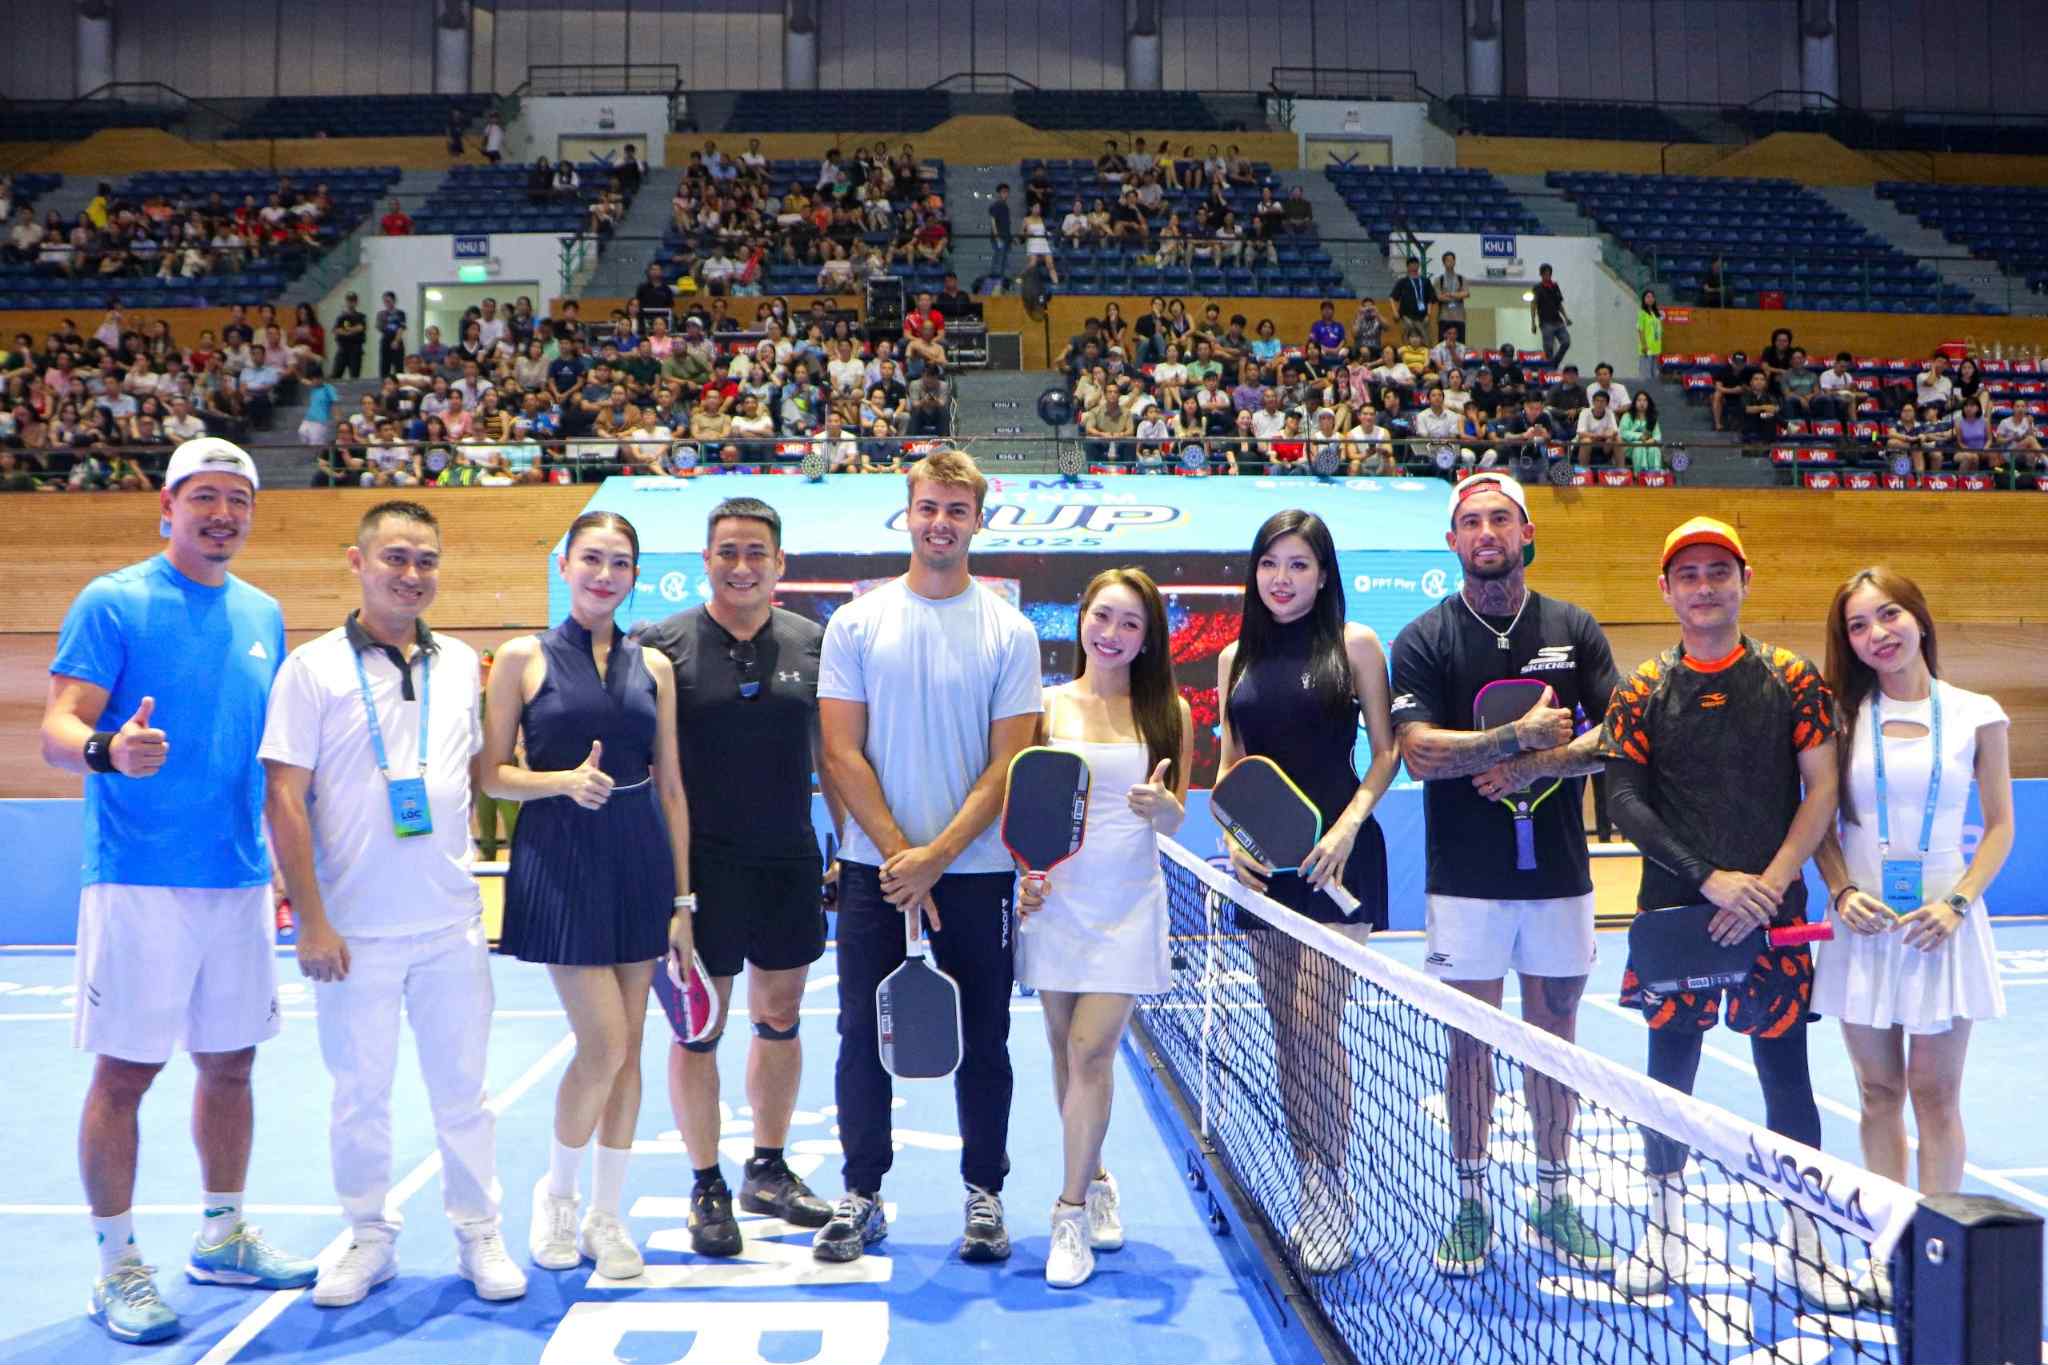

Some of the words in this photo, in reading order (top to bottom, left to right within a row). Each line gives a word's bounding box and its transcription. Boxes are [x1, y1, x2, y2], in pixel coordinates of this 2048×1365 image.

[1485, 241, 1504, 253] KHU
[1507, 241, 1513, 253] B
[1809, 450, 1829, 462] VIP
[1028, 480, 1104, 490] MB
[1604, 474, 1625, 486] VIP
[1645, 476, 1664, 486] VIP
[1809, 479, 1830, 489] VIP
[1851, 479, 1871, 489] VIP
[1928, 480, 1949, 490] VIP
[1966, 480, 1984, 490] VIP
[984, 537, 1103, 547] 2025
[1372, 578, 1393, 589] FPT
[1394, 578, 1416, 592] Play
[1769, 1149, 1875, 1232] JOOLA
